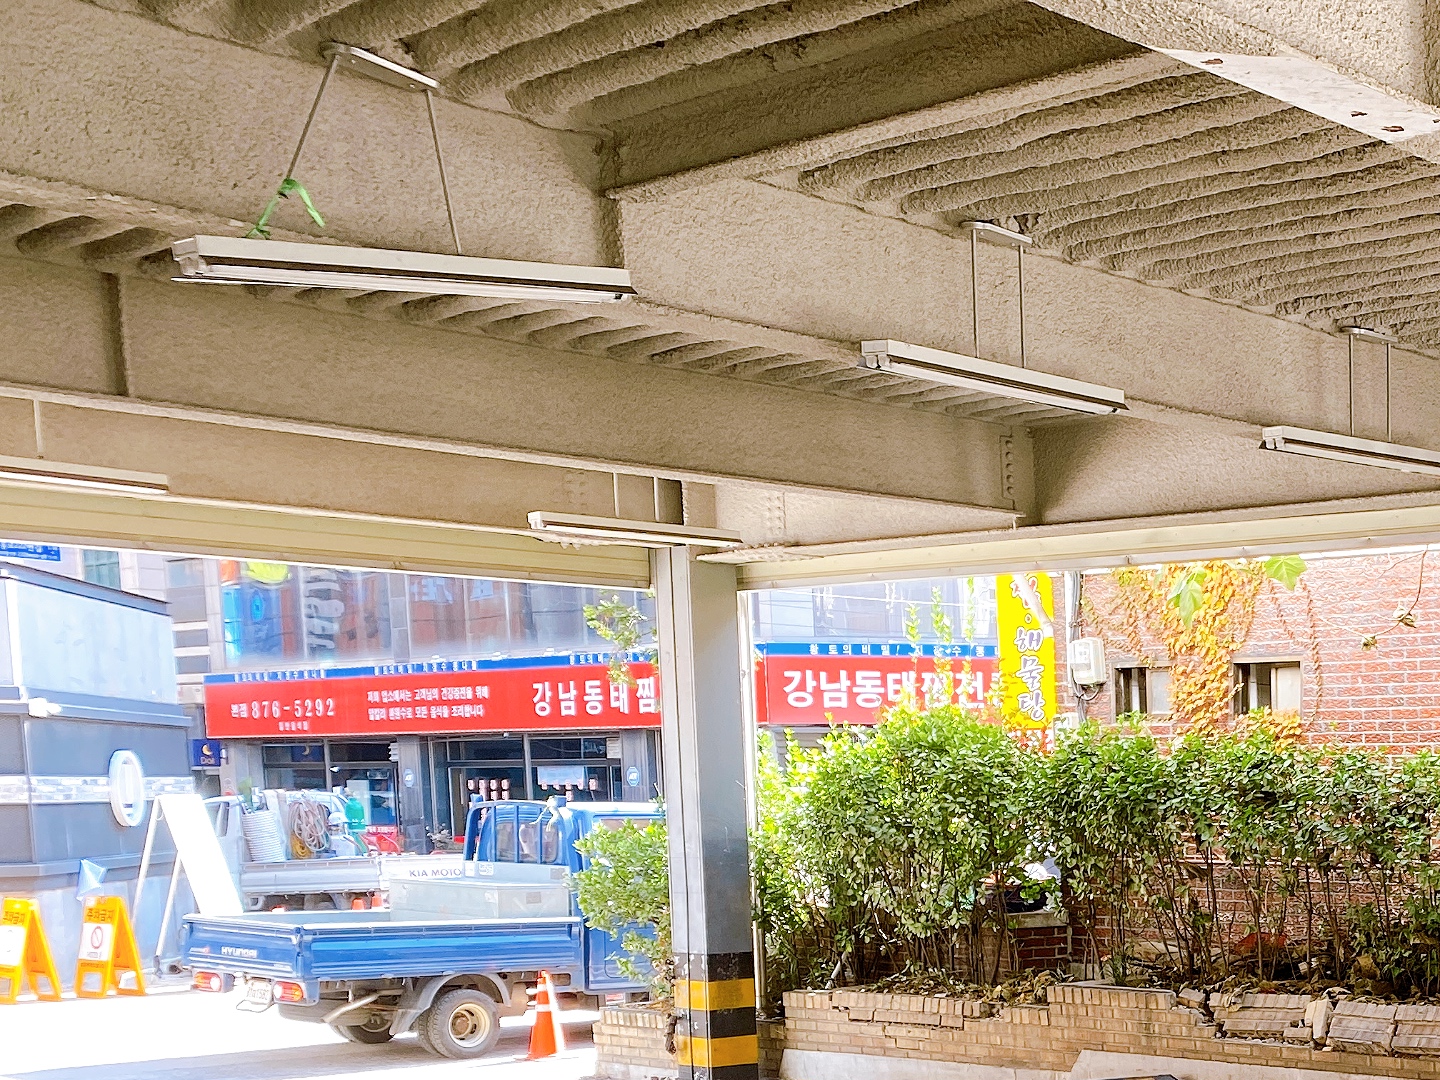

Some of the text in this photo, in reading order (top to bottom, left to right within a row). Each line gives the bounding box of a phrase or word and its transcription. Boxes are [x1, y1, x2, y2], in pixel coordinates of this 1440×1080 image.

[532, 677, 656, 716] 강남동태찜
[251, 698, 335, 719] 876-5292
[409, 867, 428, 877] KIA
